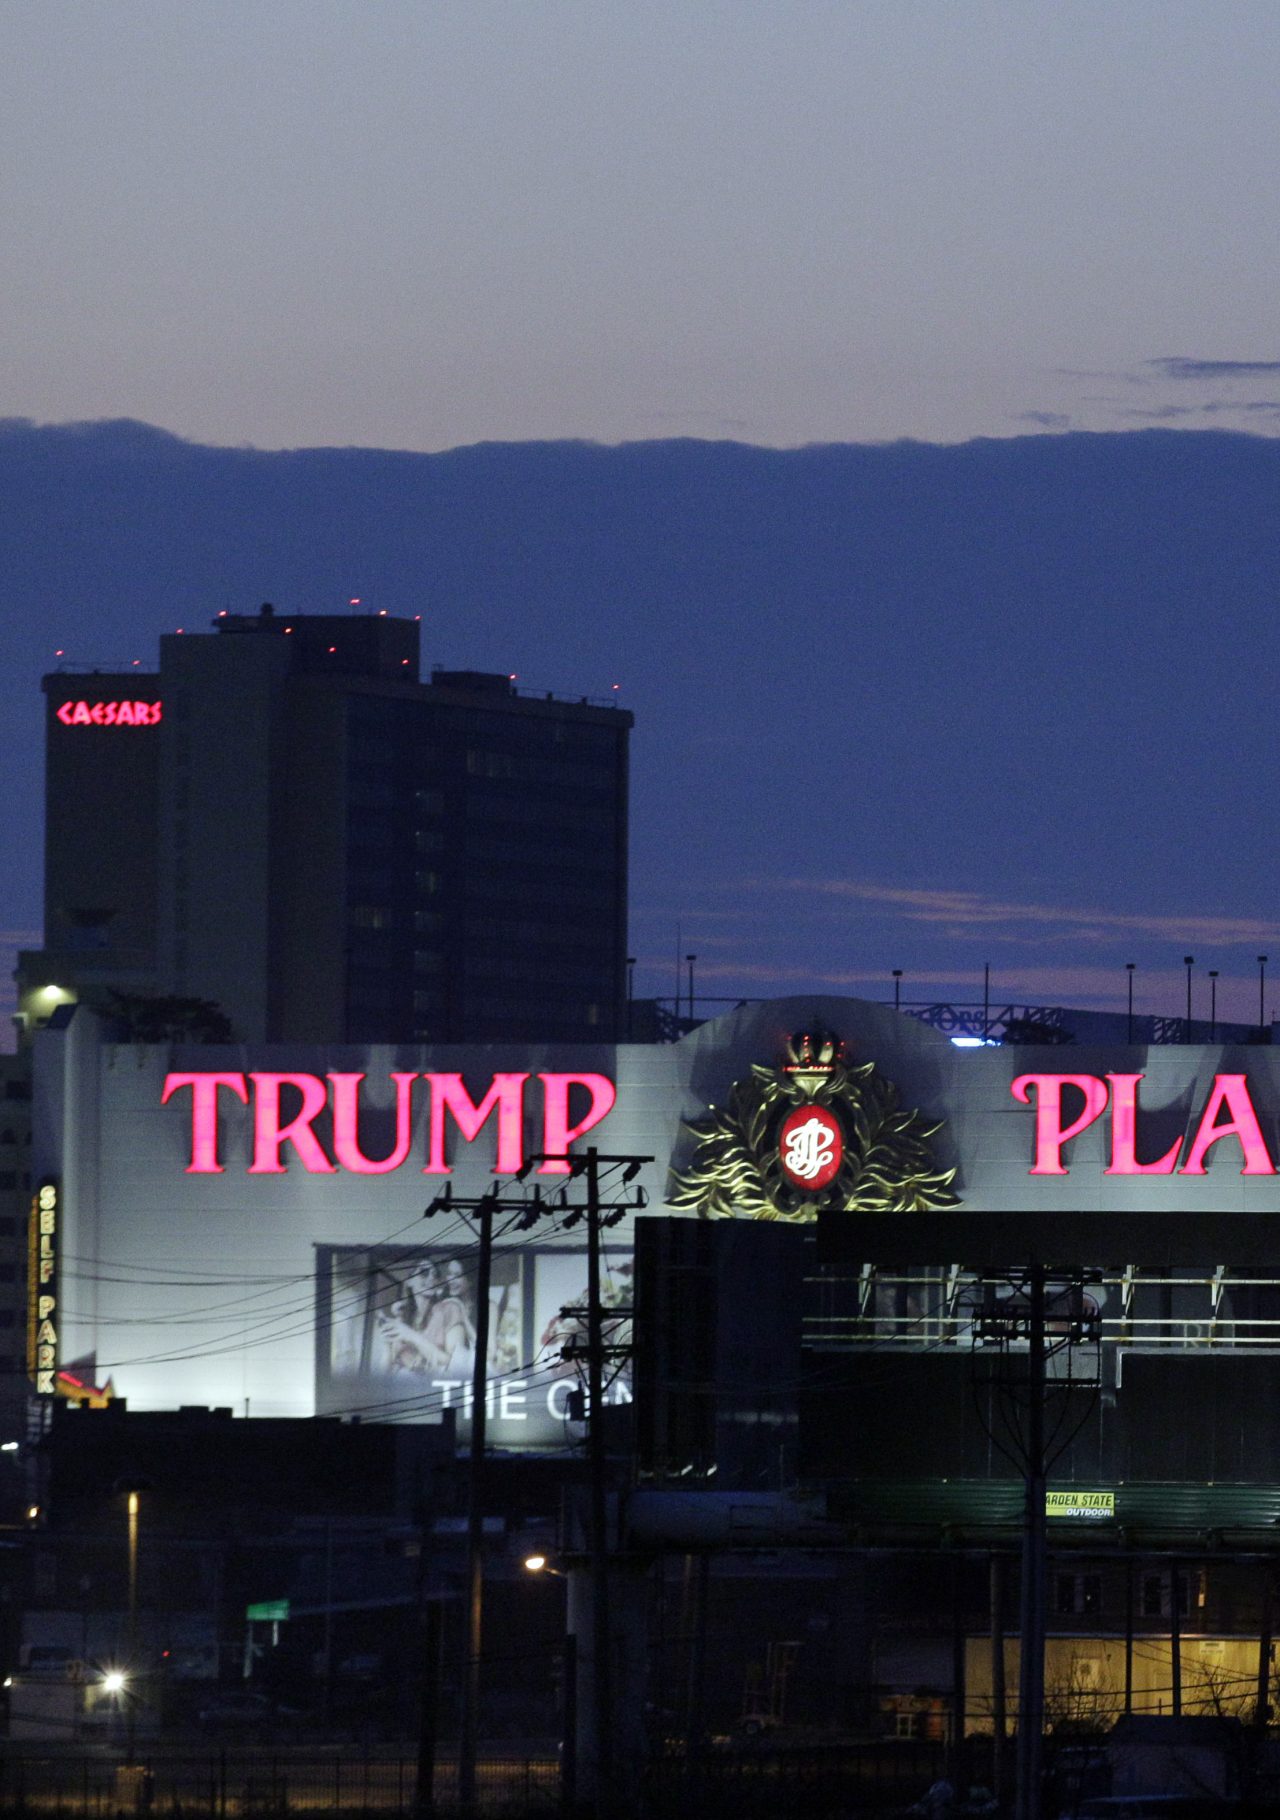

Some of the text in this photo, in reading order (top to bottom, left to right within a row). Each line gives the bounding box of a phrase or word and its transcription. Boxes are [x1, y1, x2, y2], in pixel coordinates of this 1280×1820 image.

[56, 700, 162, 726] CAESARS
[160, 1072, 617, 1175] TRUMP
[37, 1185, 57, 1393] SELF PARK
[432, 1380, 528, 1420] THE
[1046, 1494, 1112, 1507] ARDEN STATE
[1066, 1508, 1111, 1517] OUTDOOR
